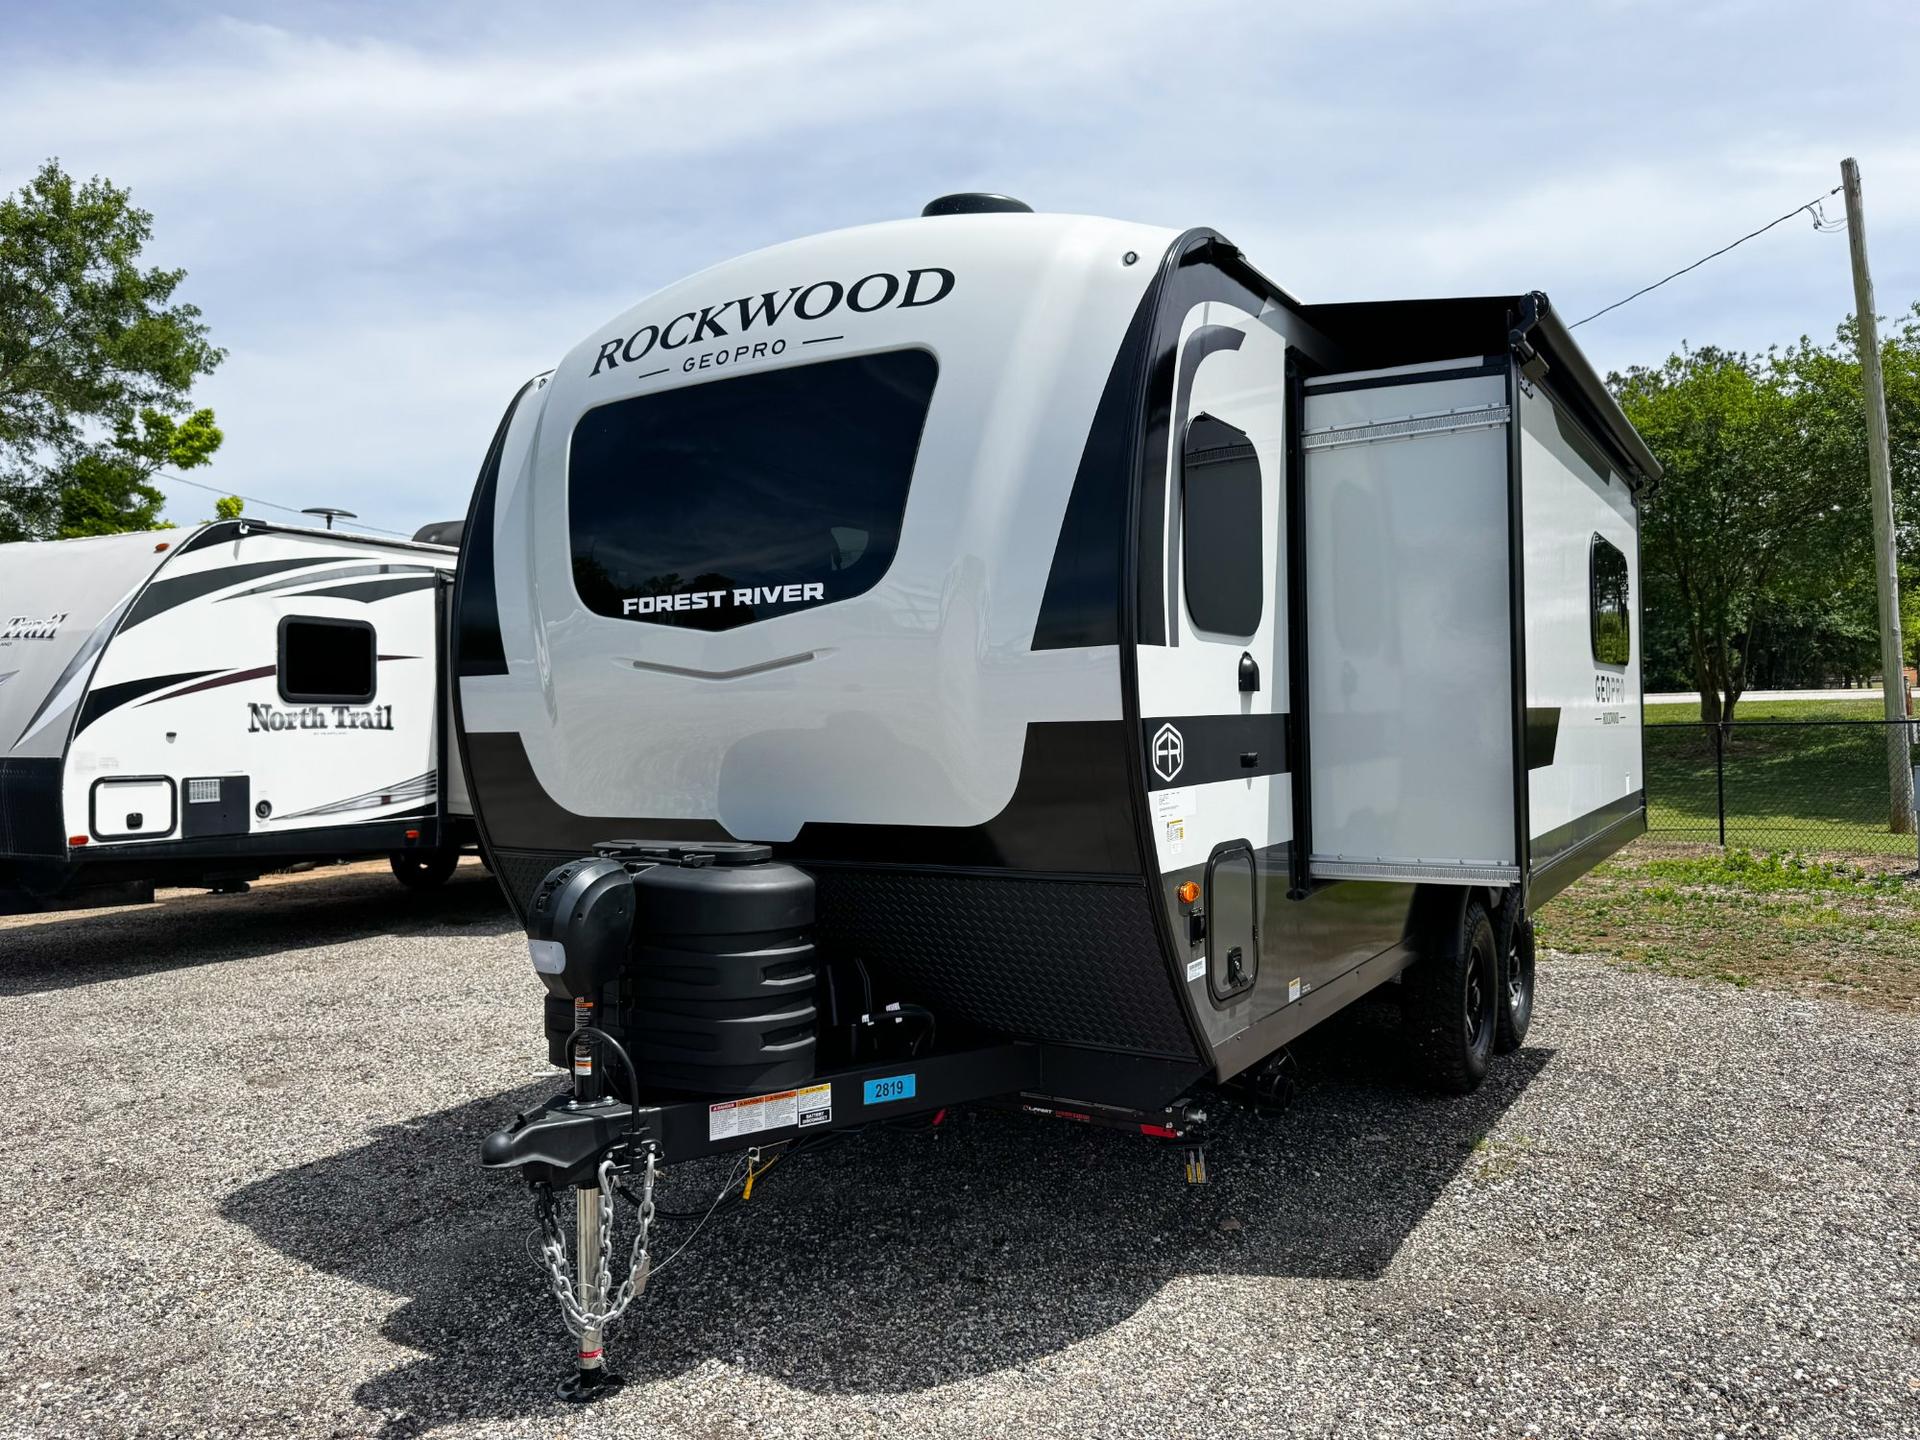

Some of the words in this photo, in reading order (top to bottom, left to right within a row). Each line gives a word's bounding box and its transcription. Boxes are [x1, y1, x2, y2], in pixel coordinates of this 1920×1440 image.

[589, 267, 955, 378] ROCKWOOD
[683, 338, 787, 373] GEOPRO
[622, 590, 727, 615] FOREST
[732, 582, 824, 606] RIVER
[0, 612, 69, 639] Trail
[1594, 674, 1625, 703] GEOPRO
[247, 702, 328, 733] North
[331, 704, 394, 731] Trail
[875, 1080, 904, 1098] 2819
